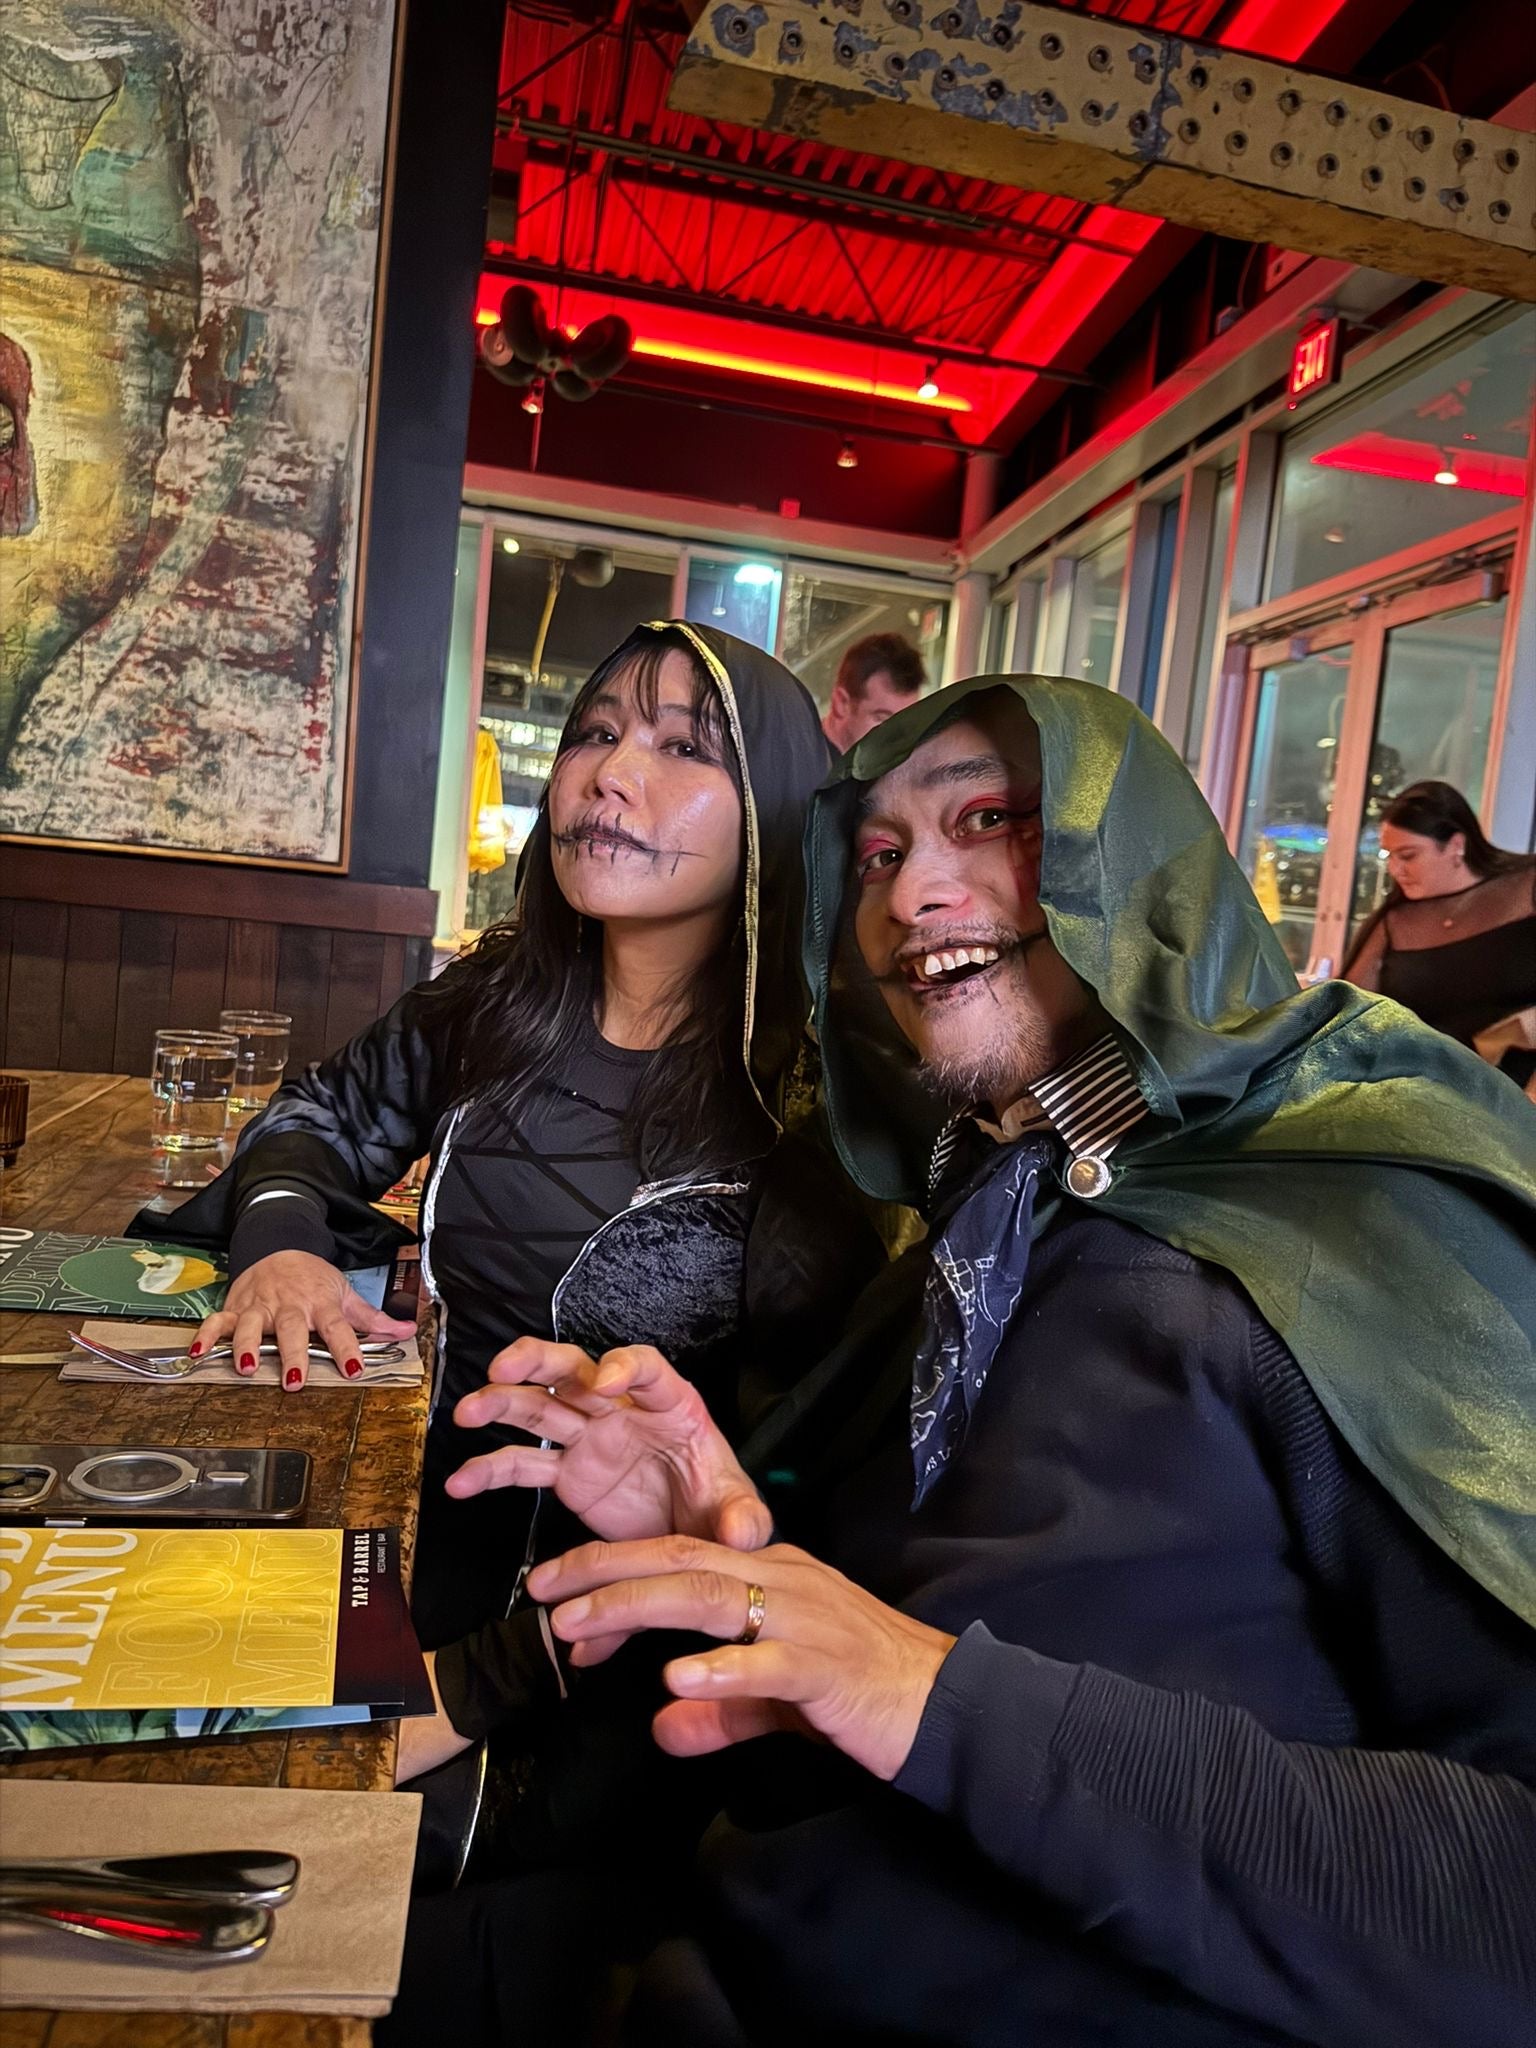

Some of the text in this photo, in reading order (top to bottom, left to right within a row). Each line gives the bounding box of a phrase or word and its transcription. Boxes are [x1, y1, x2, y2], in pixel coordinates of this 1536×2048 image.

[0, 1529, 138, 1710] MENU
[97, 1531, 240, 1706] FOOD
[226, 1531, 338, 1706] MENU
[352, 1585, 369, 1607] TAP
[353, 1533, 370, 1574] BARREL
